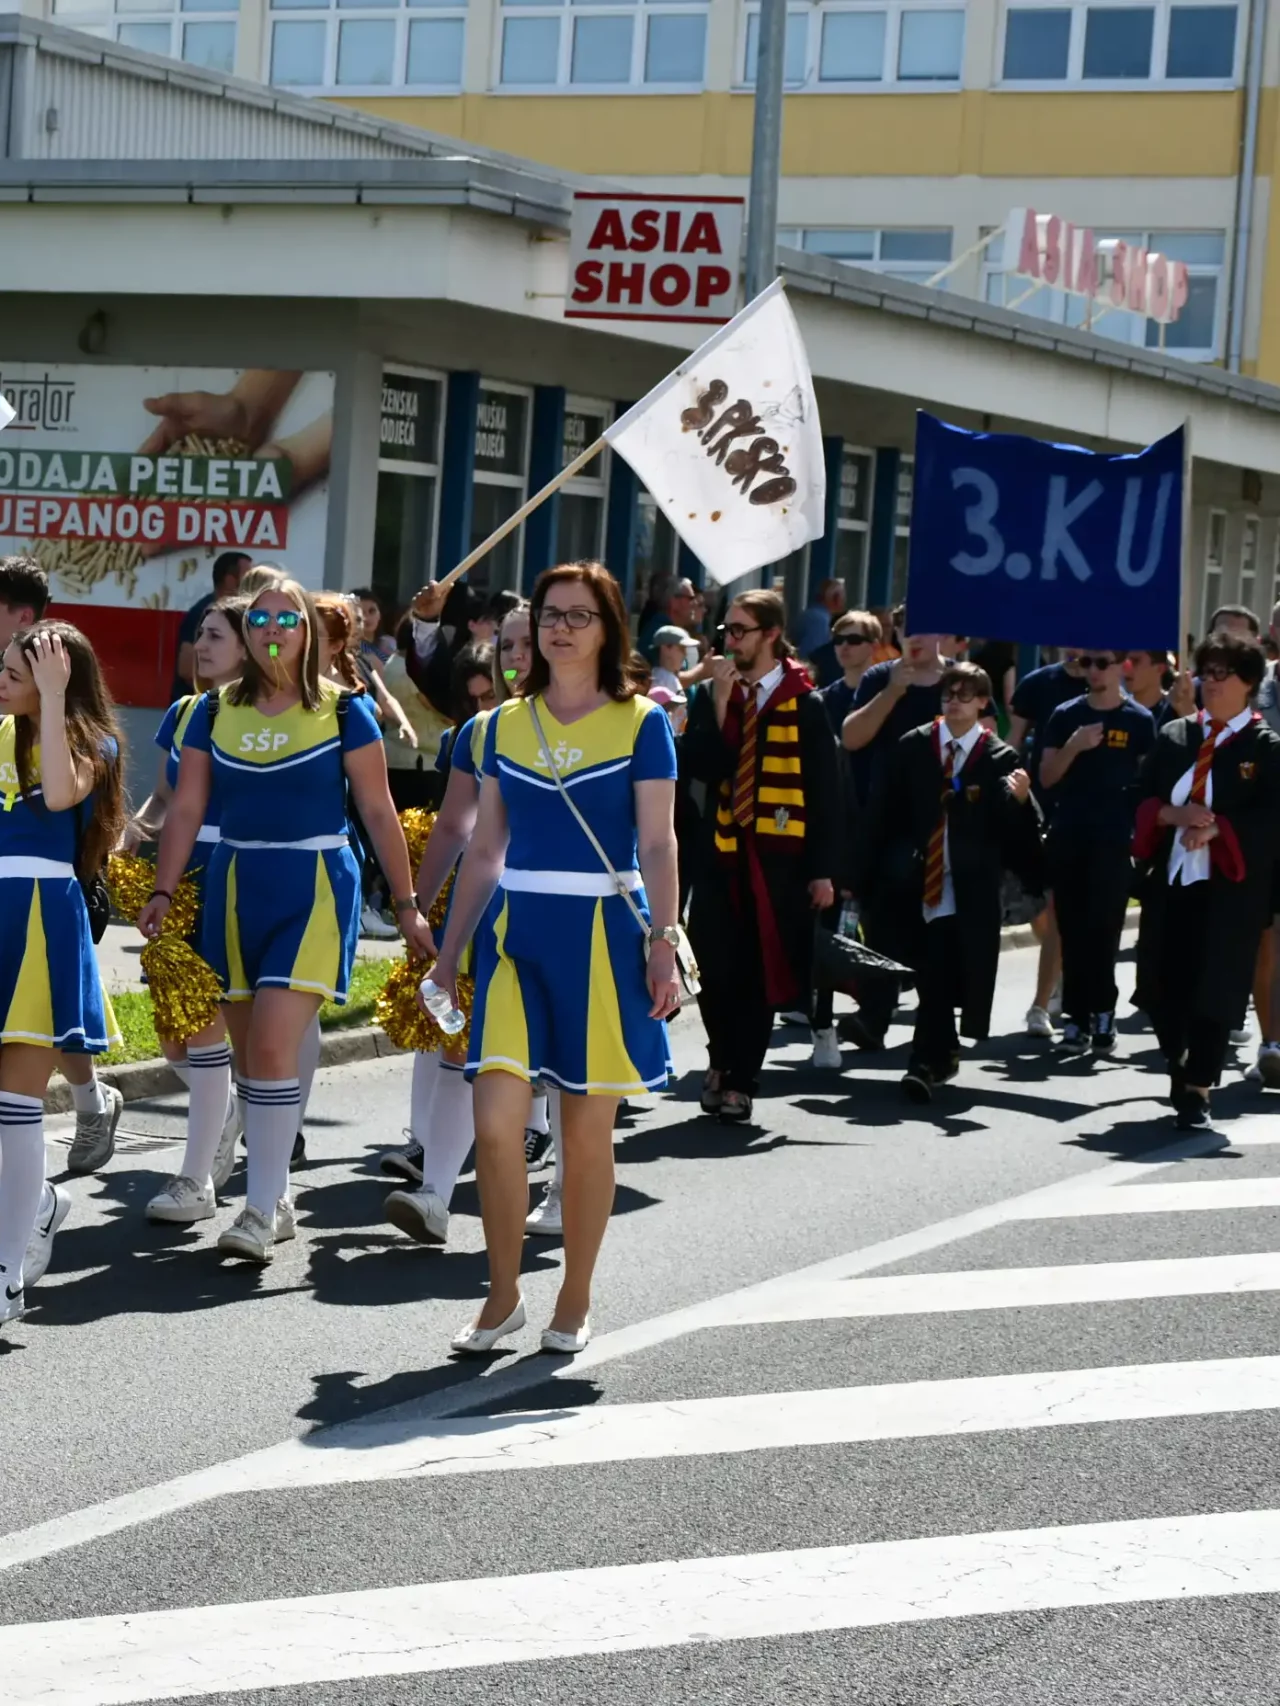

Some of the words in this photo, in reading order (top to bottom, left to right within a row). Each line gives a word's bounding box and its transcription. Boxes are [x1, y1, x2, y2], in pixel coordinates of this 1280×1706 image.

[587, 209, 722, 254] ASIA
[571, 260, 731, 307] SHOP
[381, 382, 418, 417] ŽENSKA
[380, 416, 415, 446] ODJEĆA
[130, 457, 283, 499] PELETA
[177, 508, 280, 546] DRVA
[239, 728, 288, 751] SŠP
